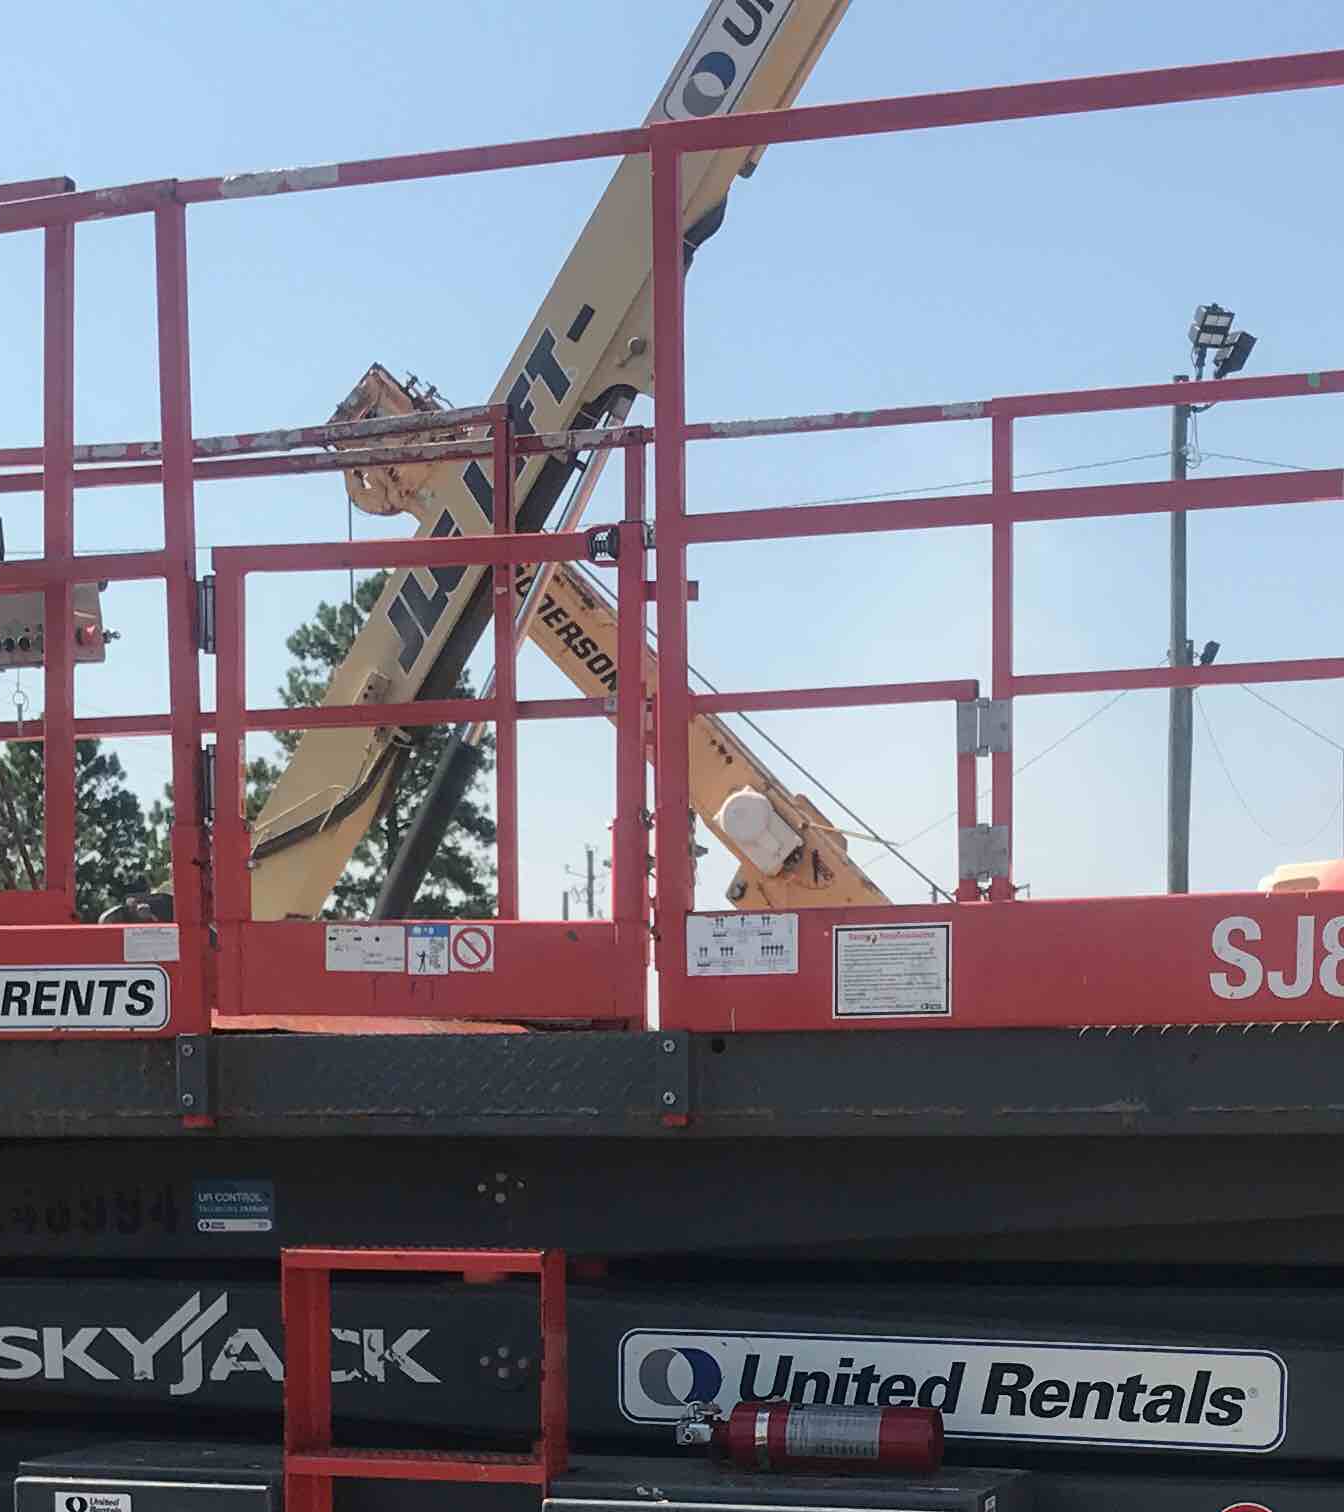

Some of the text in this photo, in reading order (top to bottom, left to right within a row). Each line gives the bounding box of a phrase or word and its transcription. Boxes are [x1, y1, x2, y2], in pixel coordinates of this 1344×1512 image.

[739, 1353, 1246, 1427] United Rentals
[90, 1496, 120, 1506] United
